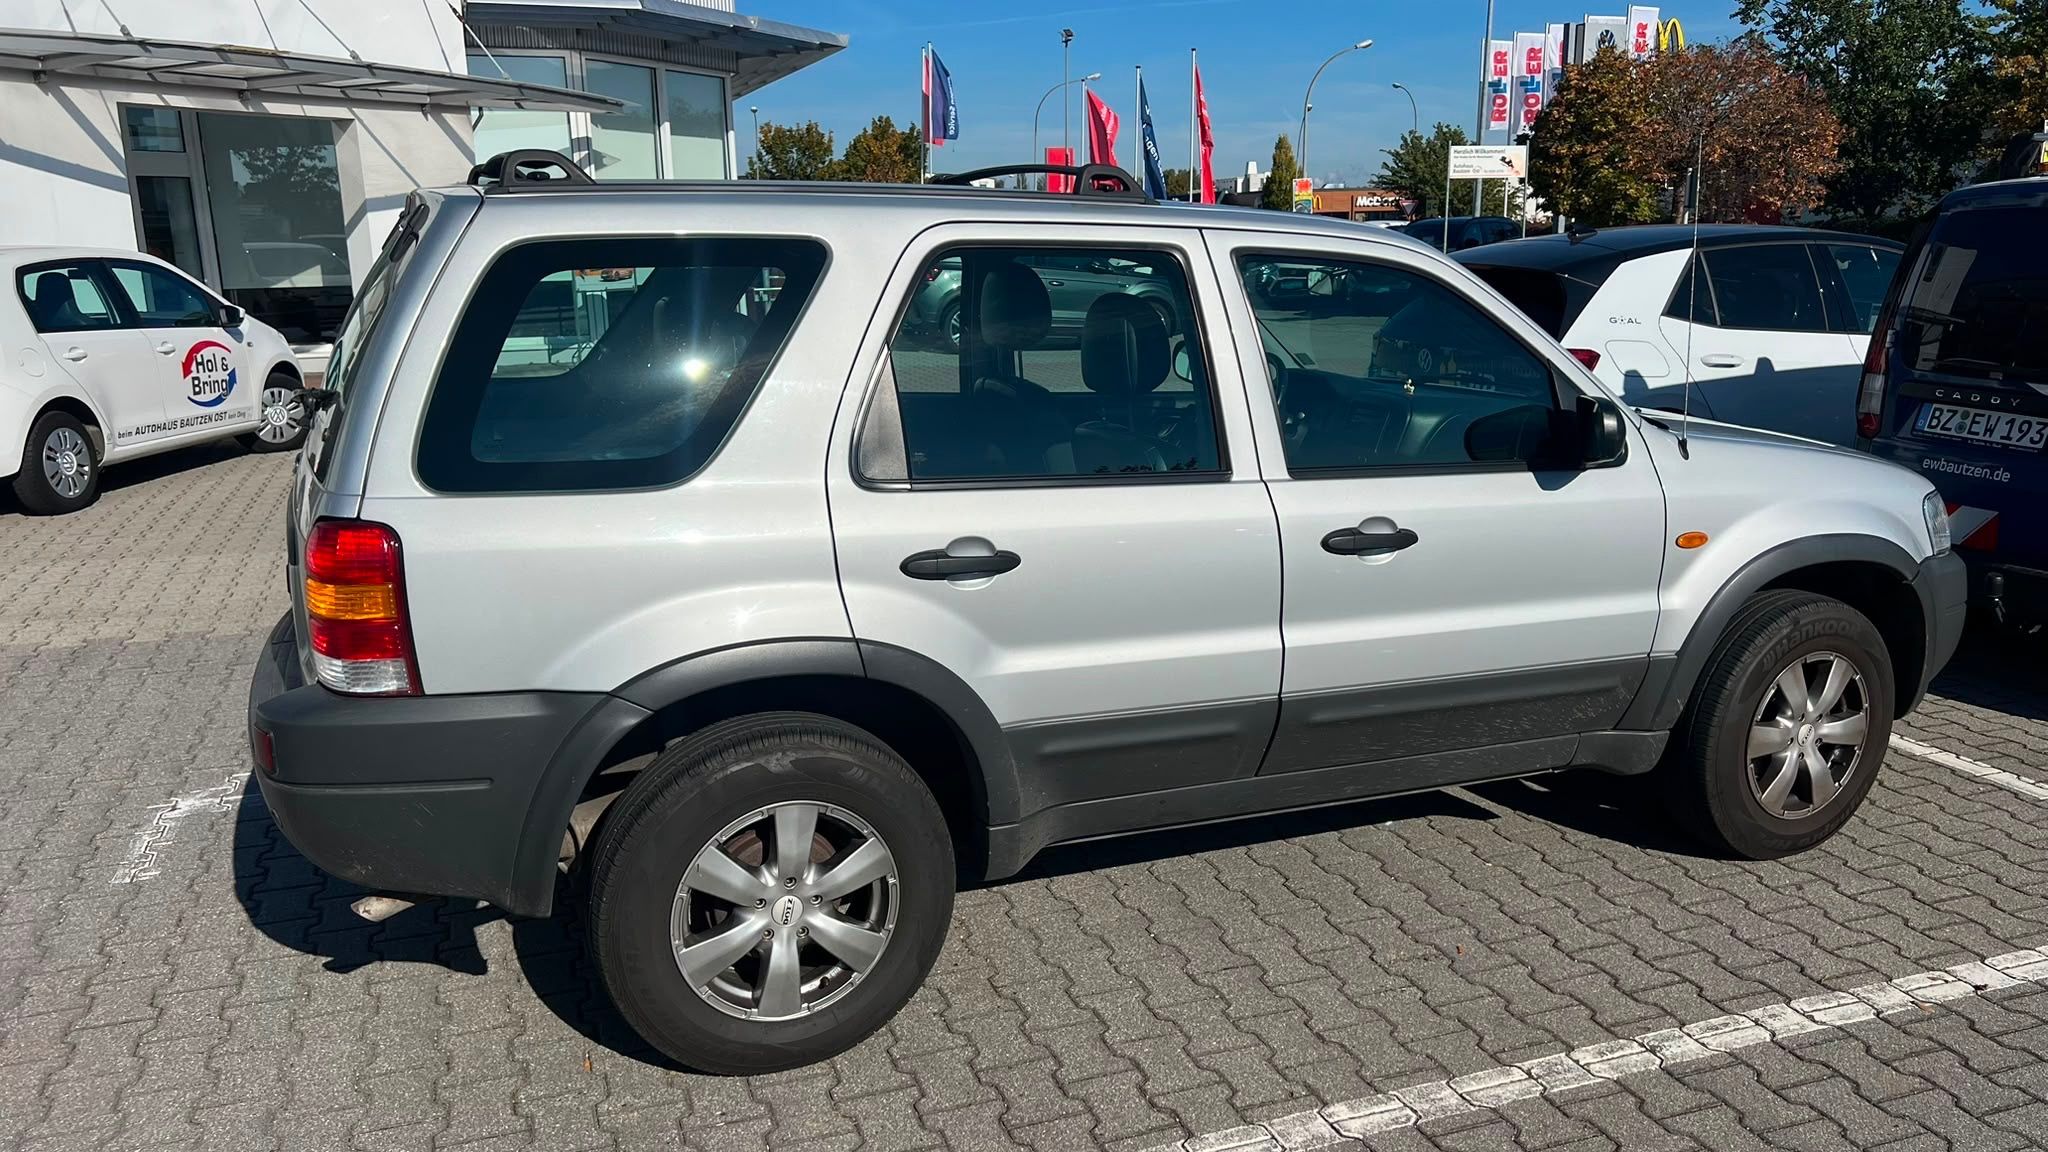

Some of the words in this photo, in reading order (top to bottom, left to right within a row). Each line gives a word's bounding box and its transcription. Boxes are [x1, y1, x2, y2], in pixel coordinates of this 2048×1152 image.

[1488, 50, 1509, 122] ROLLER
[1519, 47, 1543, 124] ROLLER
[194, 353, 218, 374] Hol
[221, 356, 229, 372] &
[191, 375, 229, 398] Bring
[1935, 389, 2021, 407] CADDY
[118, 428, 133, 439] beim
[135, 420, 178, 435] AUTOHAUS
[179, 414, 213, 429] BAUTZEN
[213, 411, 228, 423] OST
[1926, 407, 1959, 433] BZ
[1966, 412, 2002, 439] EW
[1999, 417, 2048, 446] 193
[1922, 457, 2011, 483] ewbautzen.de
